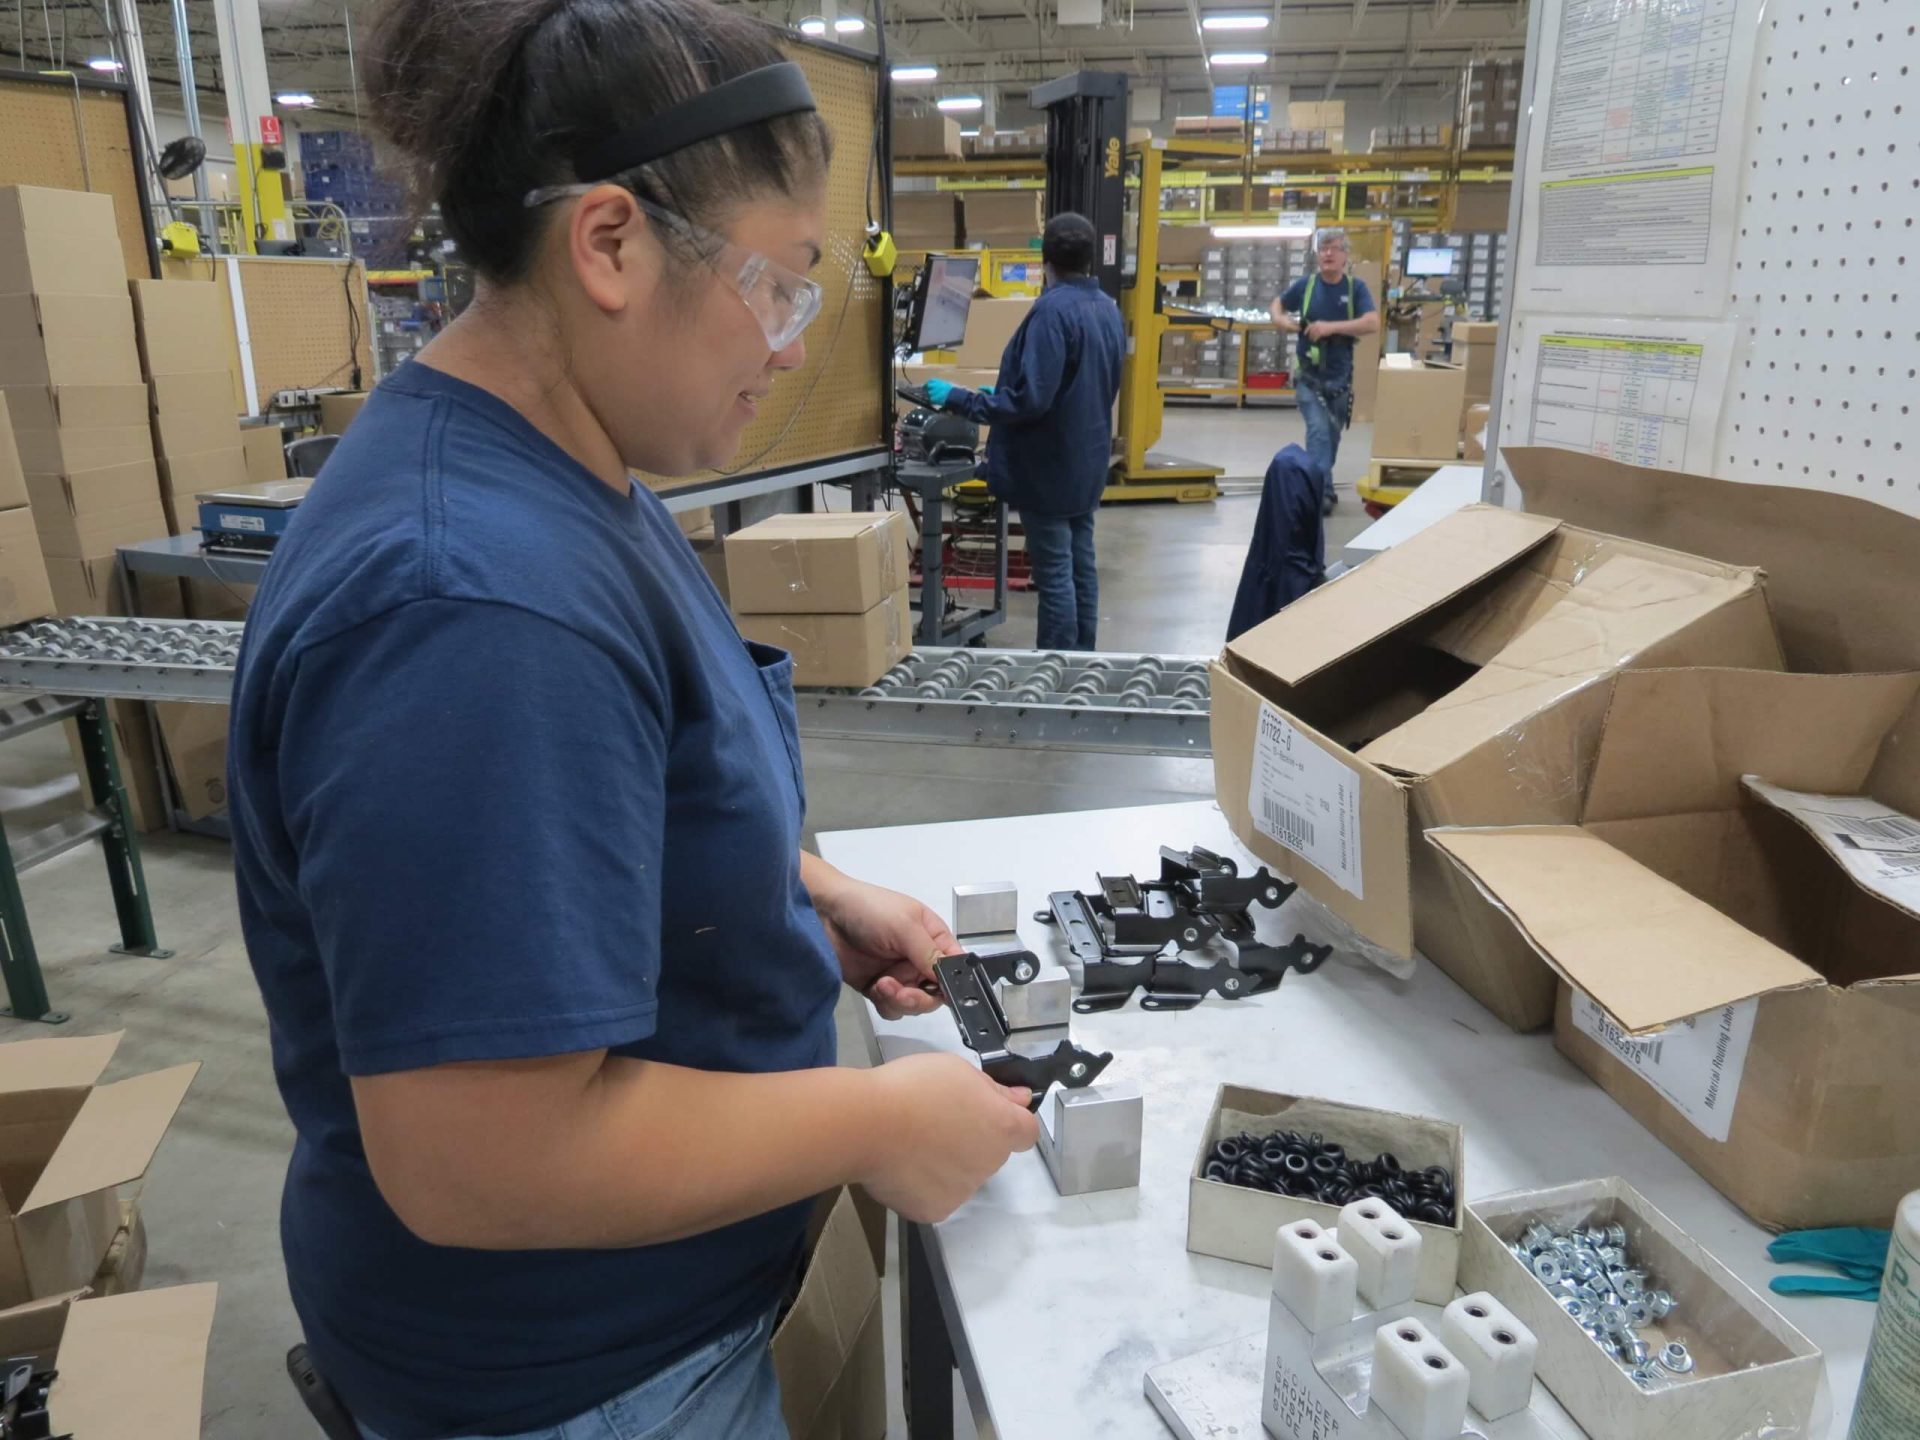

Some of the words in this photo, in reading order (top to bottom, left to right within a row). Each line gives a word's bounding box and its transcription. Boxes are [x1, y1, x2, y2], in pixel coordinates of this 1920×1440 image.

[1105, 137, 1120, 178] Yale
[1711, 1032, 1731, 1070] Routing
[1704, 1069, 1721, 1110] Material
[1273, 1383, 1304, 1424] MUST
[1275, 1370, 1330, 1438] GROMMET
[1276, 1355, 1339, 1437] SOULDER
[1272, 1398, 1301, 1438] SIDE
